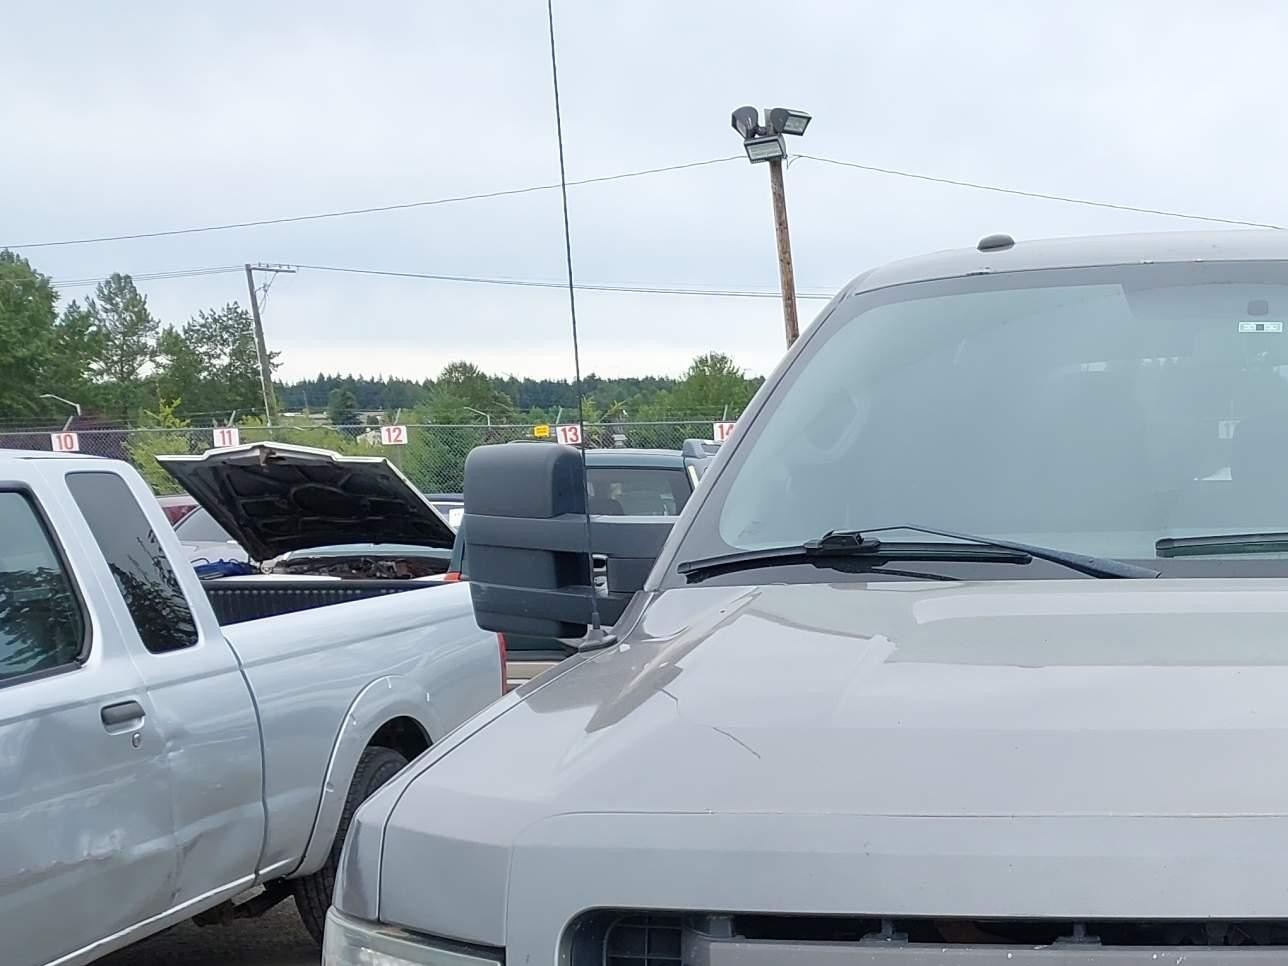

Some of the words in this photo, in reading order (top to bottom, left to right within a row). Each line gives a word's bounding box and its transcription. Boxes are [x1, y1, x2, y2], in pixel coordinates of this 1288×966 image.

[56, 434, 75, 450] 10
[218, 430, 233, 445] 11
[384, 427, 404, 443] 12
[560, 426, 579, 443] 13
